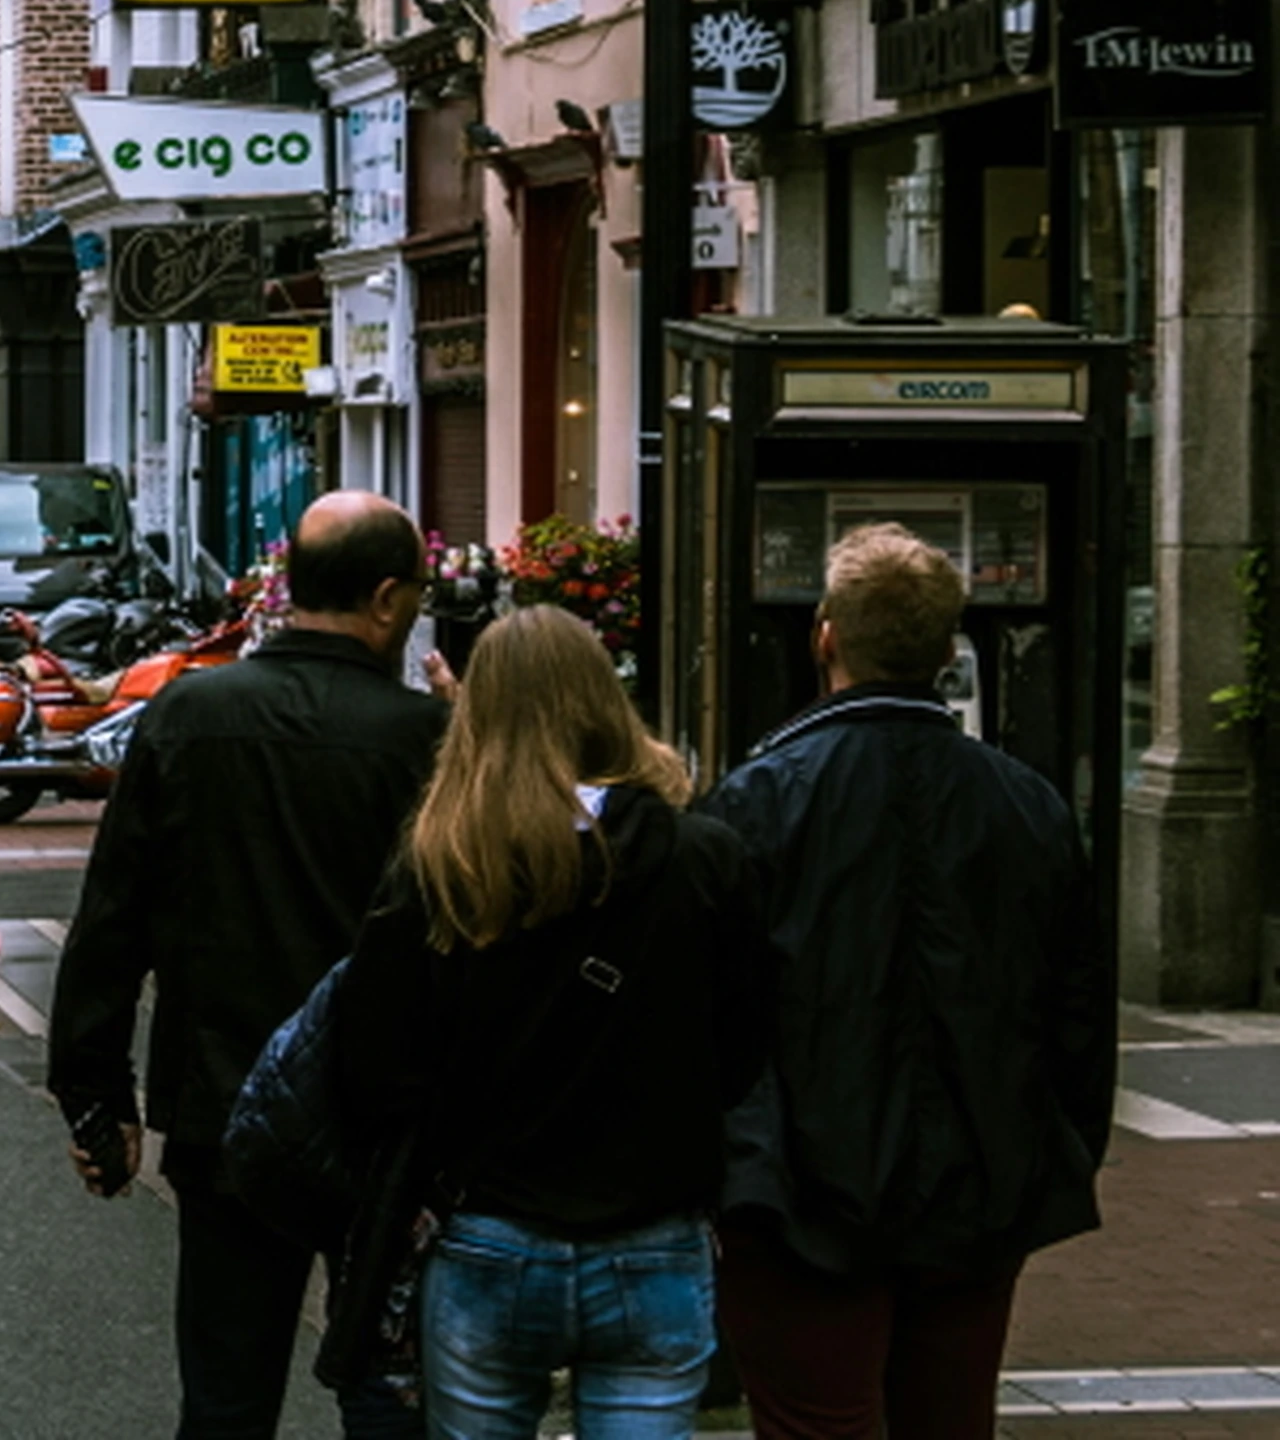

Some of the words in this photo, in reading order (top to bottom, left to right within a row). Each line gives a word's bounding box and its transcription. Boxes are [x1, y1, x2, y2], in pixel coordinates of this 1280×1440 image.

[113, 140, 143, 171] e
[155, 135, 232, 178] cig
[244, 131, 311, 167] co
